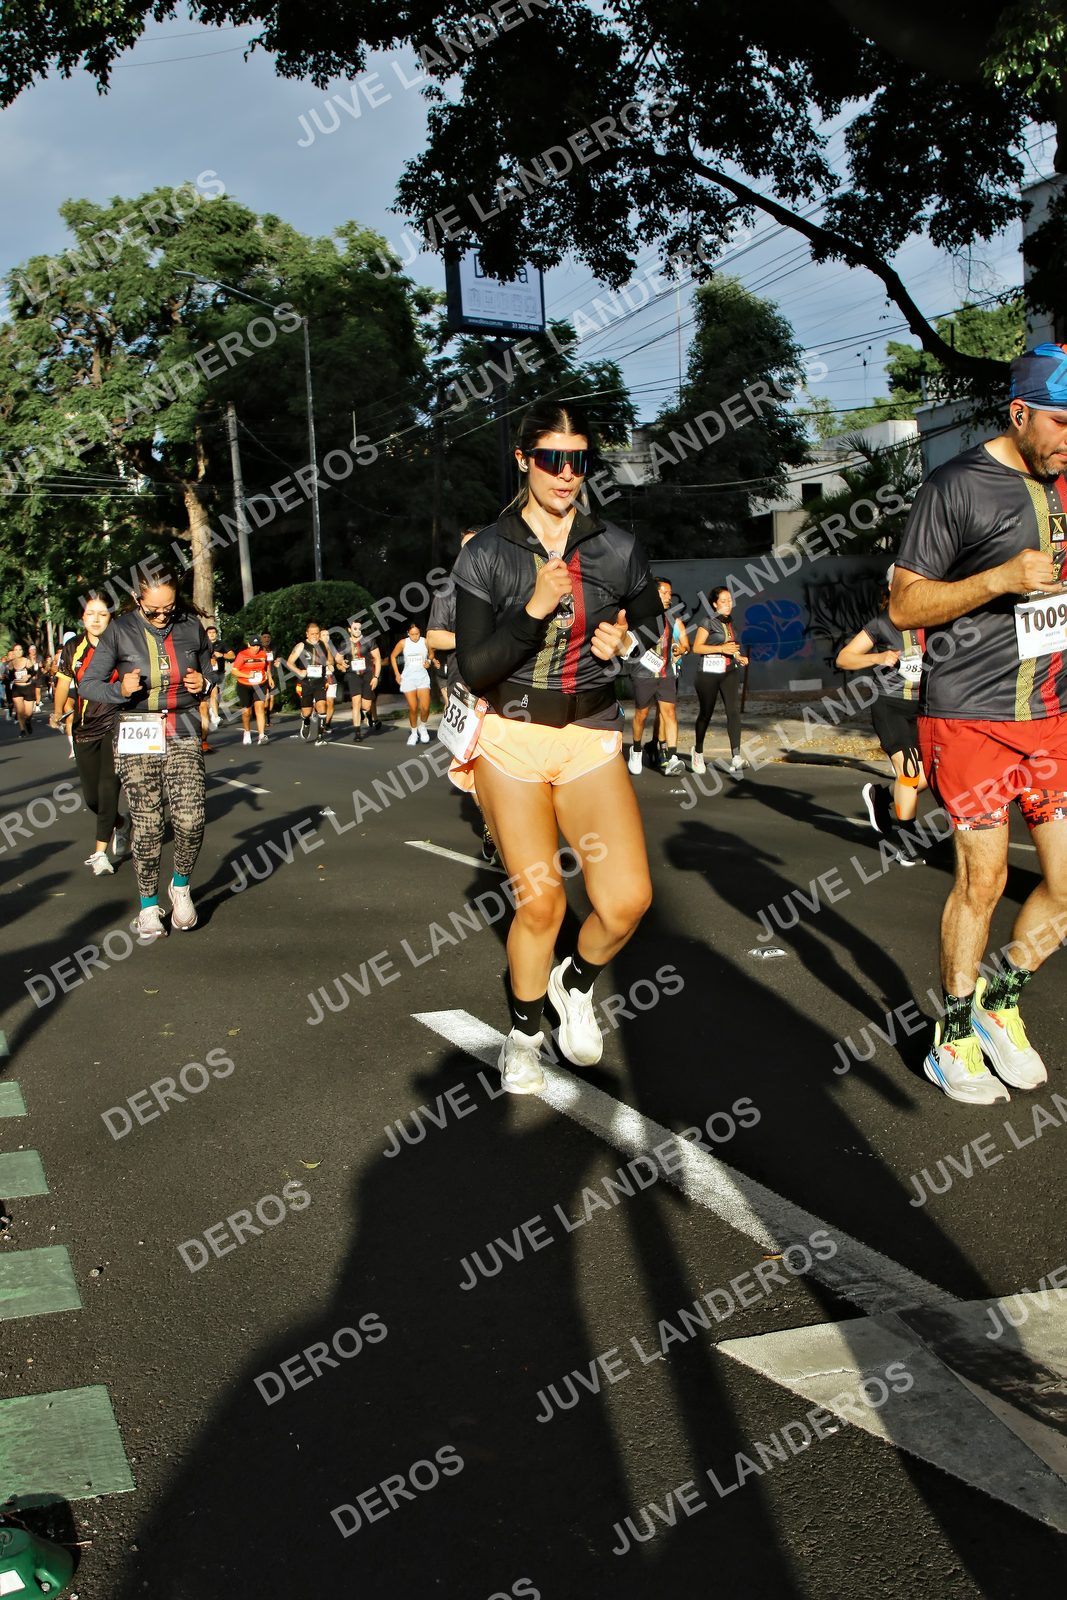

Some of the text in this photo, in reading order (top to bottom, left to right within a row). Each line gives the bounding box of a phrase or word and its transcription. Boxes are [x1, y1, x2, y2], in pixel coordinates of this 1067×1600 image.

[1020, 604, 1067, 634] 1009
[121, 727, 159, 740] 12647
[931, 1045, 940, 1066] OKA
